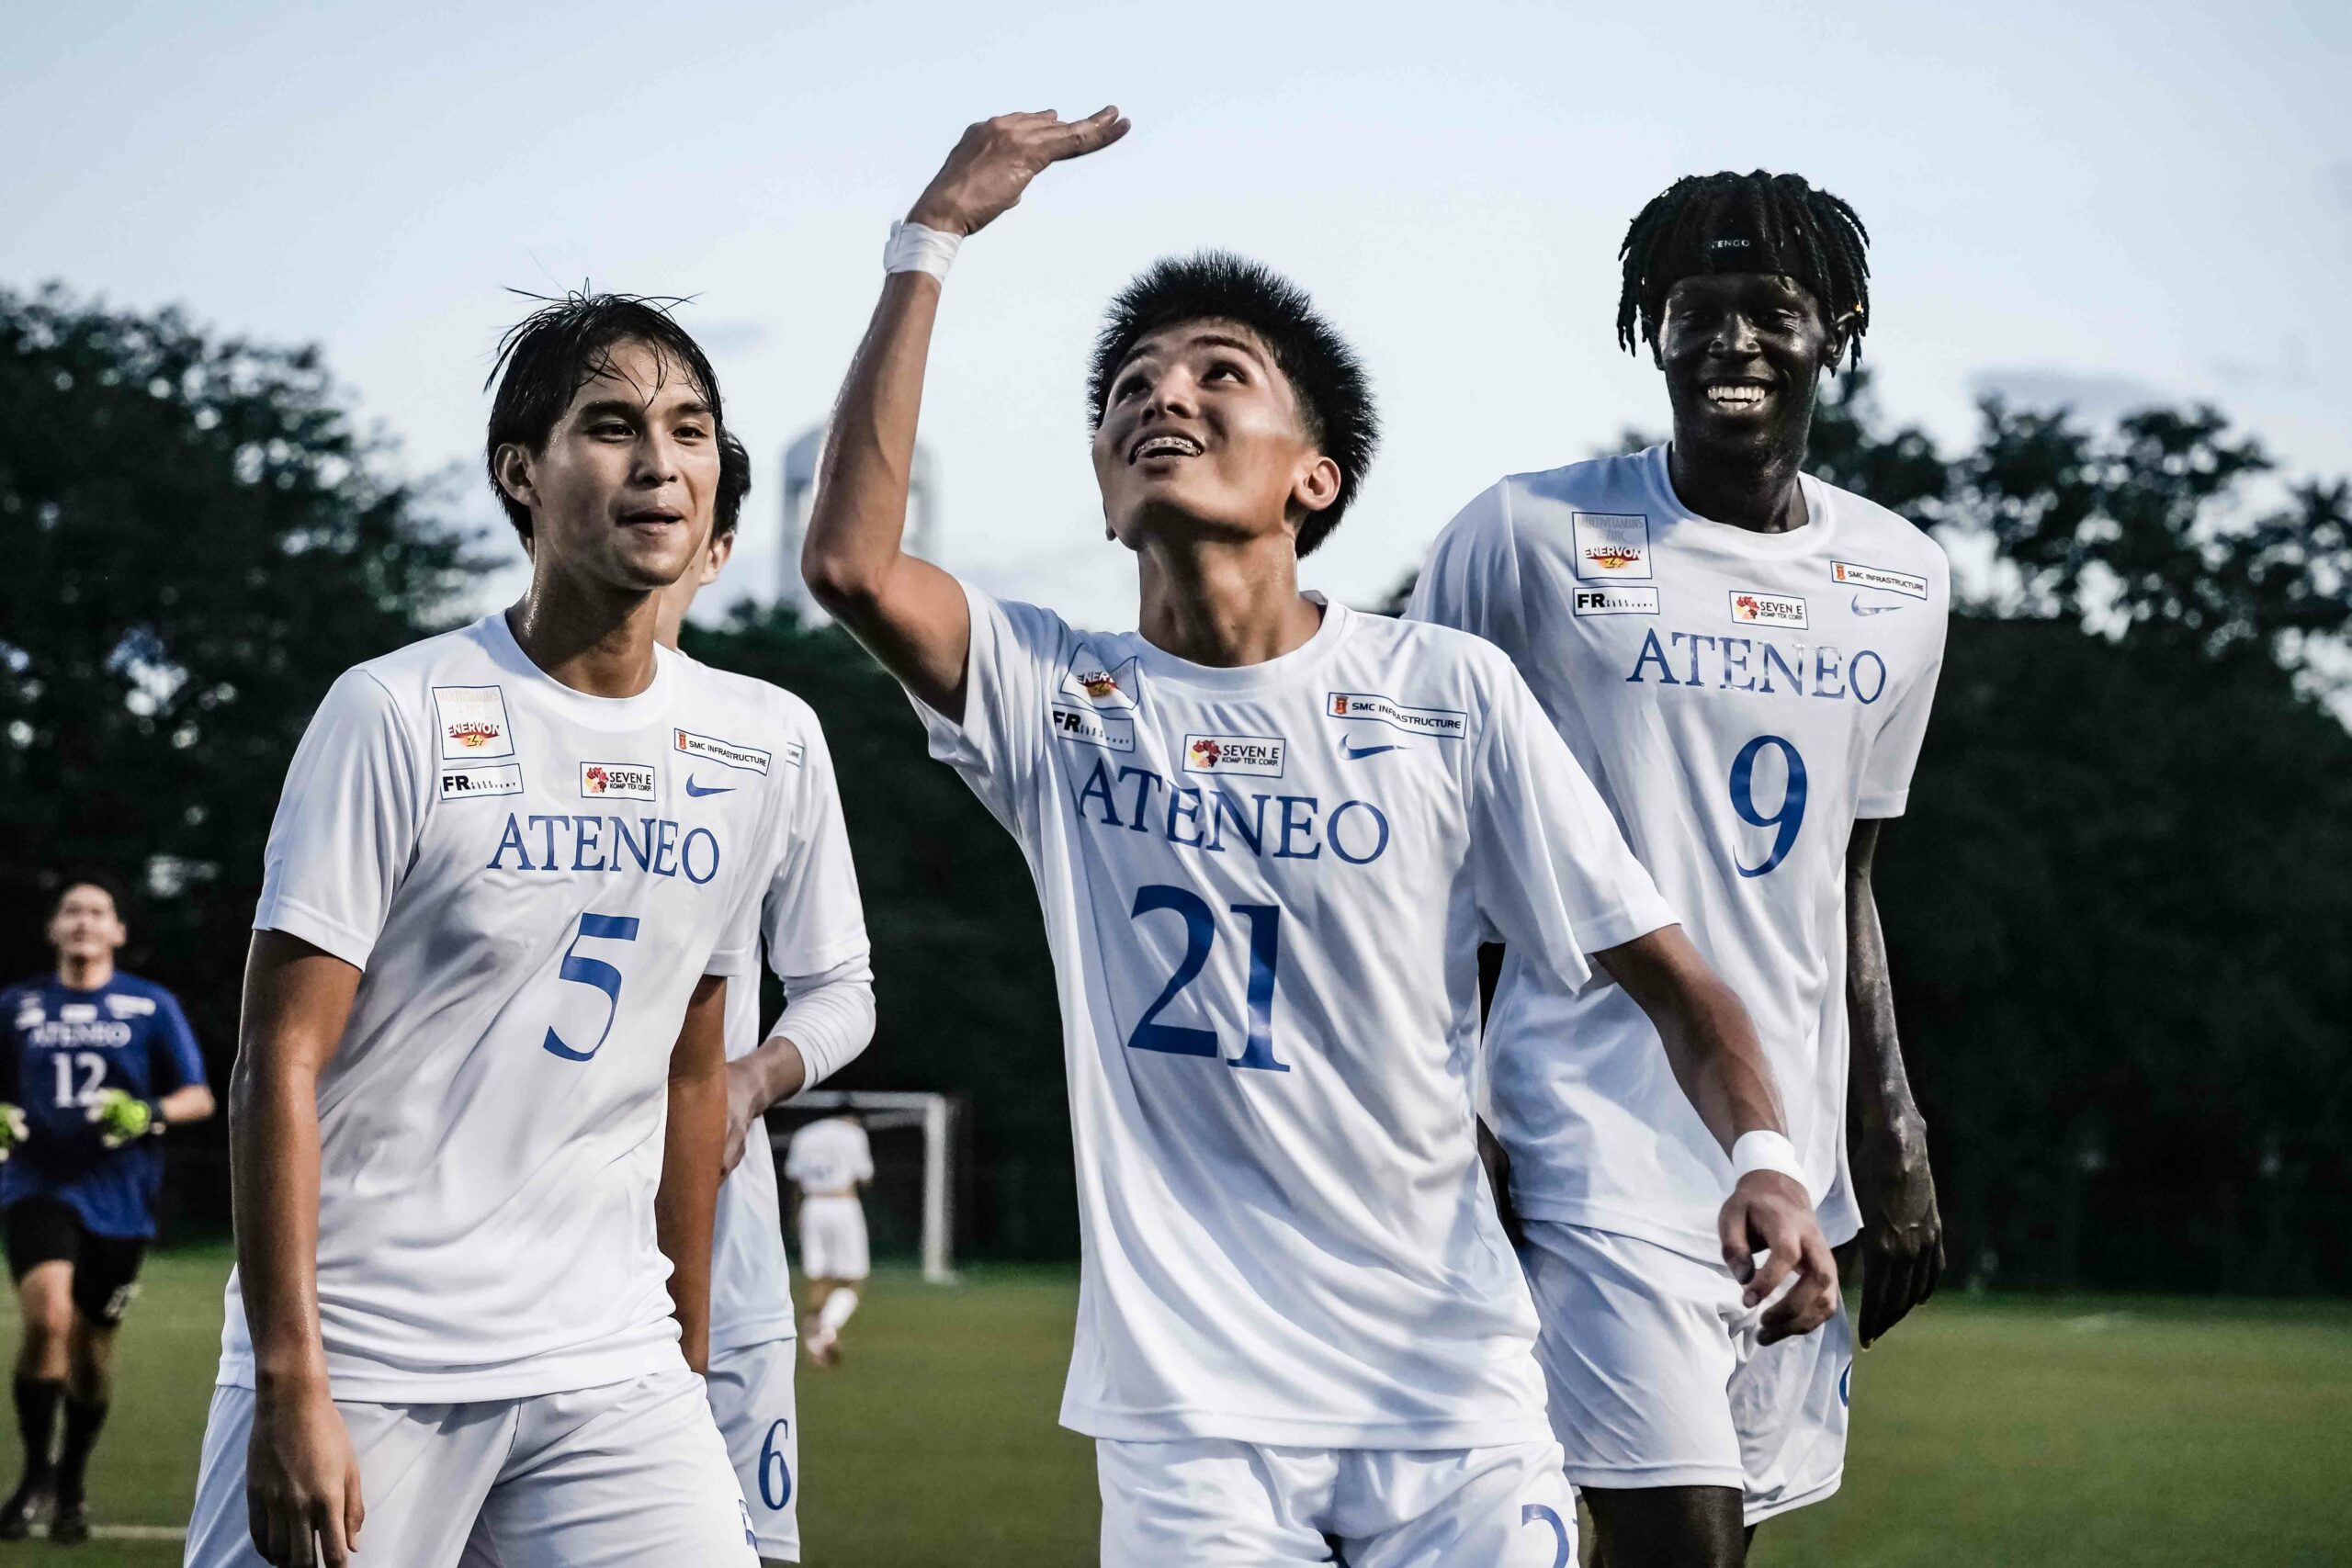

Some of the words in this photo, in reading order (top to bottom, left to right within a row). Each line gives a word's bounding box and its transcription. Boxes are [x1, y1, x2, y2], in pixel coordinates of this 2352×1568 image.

[1585, 546, 1642, 559] ENERVON
[1848, 570, 1864, 580] SMC
[1866, 573, 1924, 592] INFRASTRUCTURE
[1760, 601, 1792, 614] SEVEN
[1796, 605, 1803, 615] E
[1626, 627, 1886, 705] ATENEO
[448, 721, 500, 735] ENERVON
[1351, 702, 1375, 712] SMC
[1379, 705, 1462, 729] INFRASTRUCTURE
[689, 740, 706, 750] SMC
[707, 744, 767, 767] INFRASTRUCTURE
[1221, 756, 1241, 764] KOMP
[1223, 745, 1267, 758] SEVEN
[1272, 747, 1280, 759] E
[609, 772, 642, 784] SEVEN
[645, 774, 652, 785] E
[1080, 756, 1389, 865] ATENEO
[1729, 735, 1808, 877] 9
[486, 812, 720, 885] ATENEO
[543, 912, 640, 1062] 5
[1127, 885, 1290, 1073] 21
[53, 1051, 107, 1109] 12
[758, 1418, 791, 1511] 6
